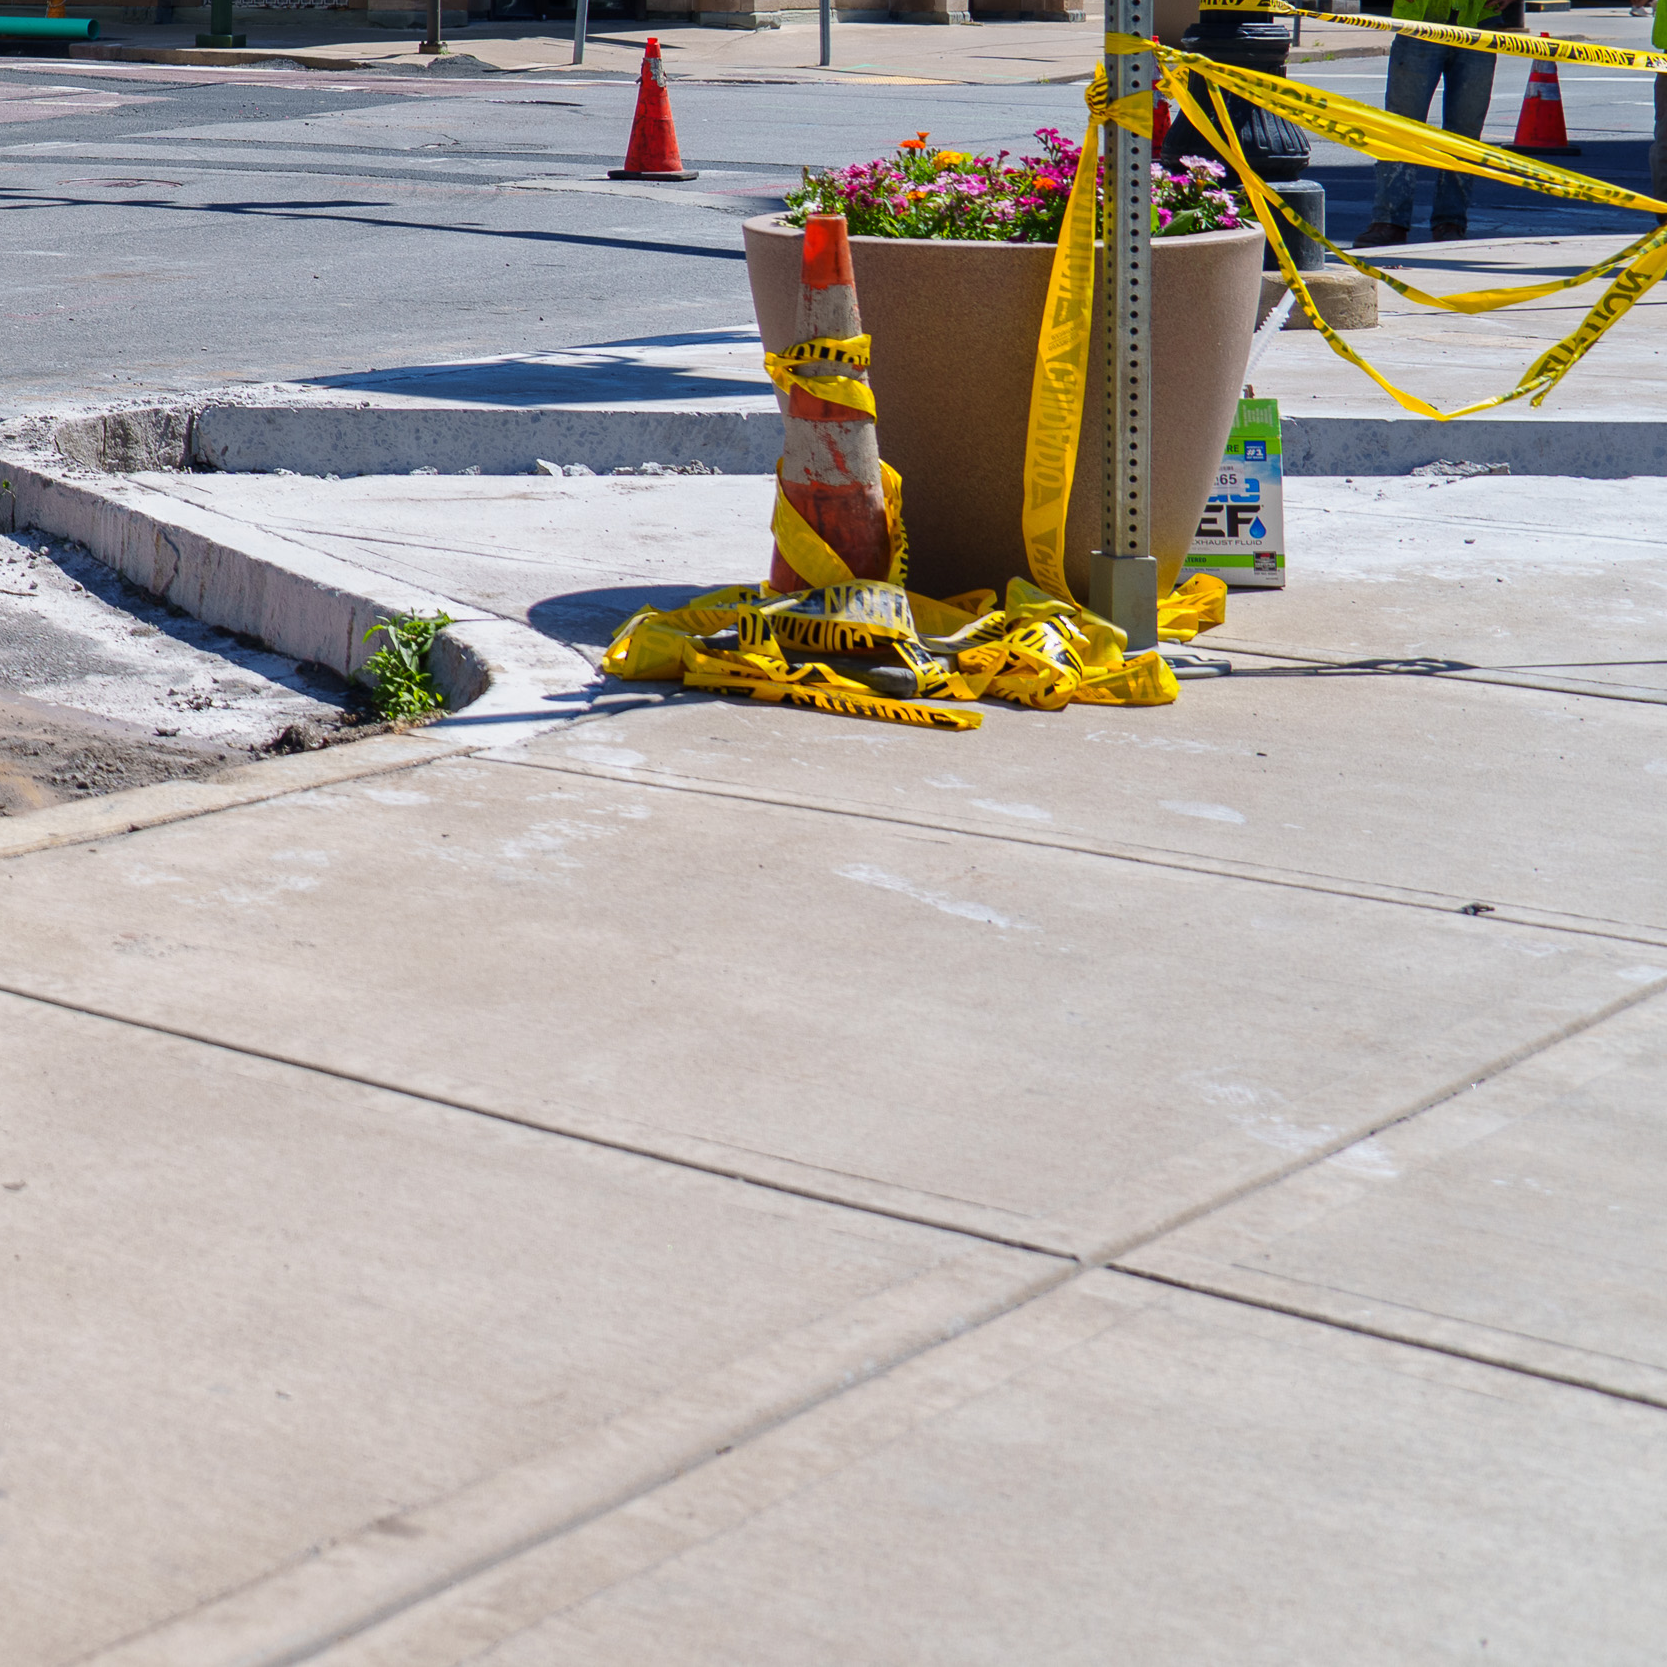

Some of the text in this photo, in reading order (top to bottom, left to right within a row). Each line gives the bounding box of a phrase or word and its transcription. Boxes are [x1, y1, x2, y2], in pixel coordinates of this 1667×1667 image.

[1495, 34, 1550, 57] CAUTION
[1573, 46, 1629, 66] CUIDADO
[1195, 504, 1261, 538] EF
